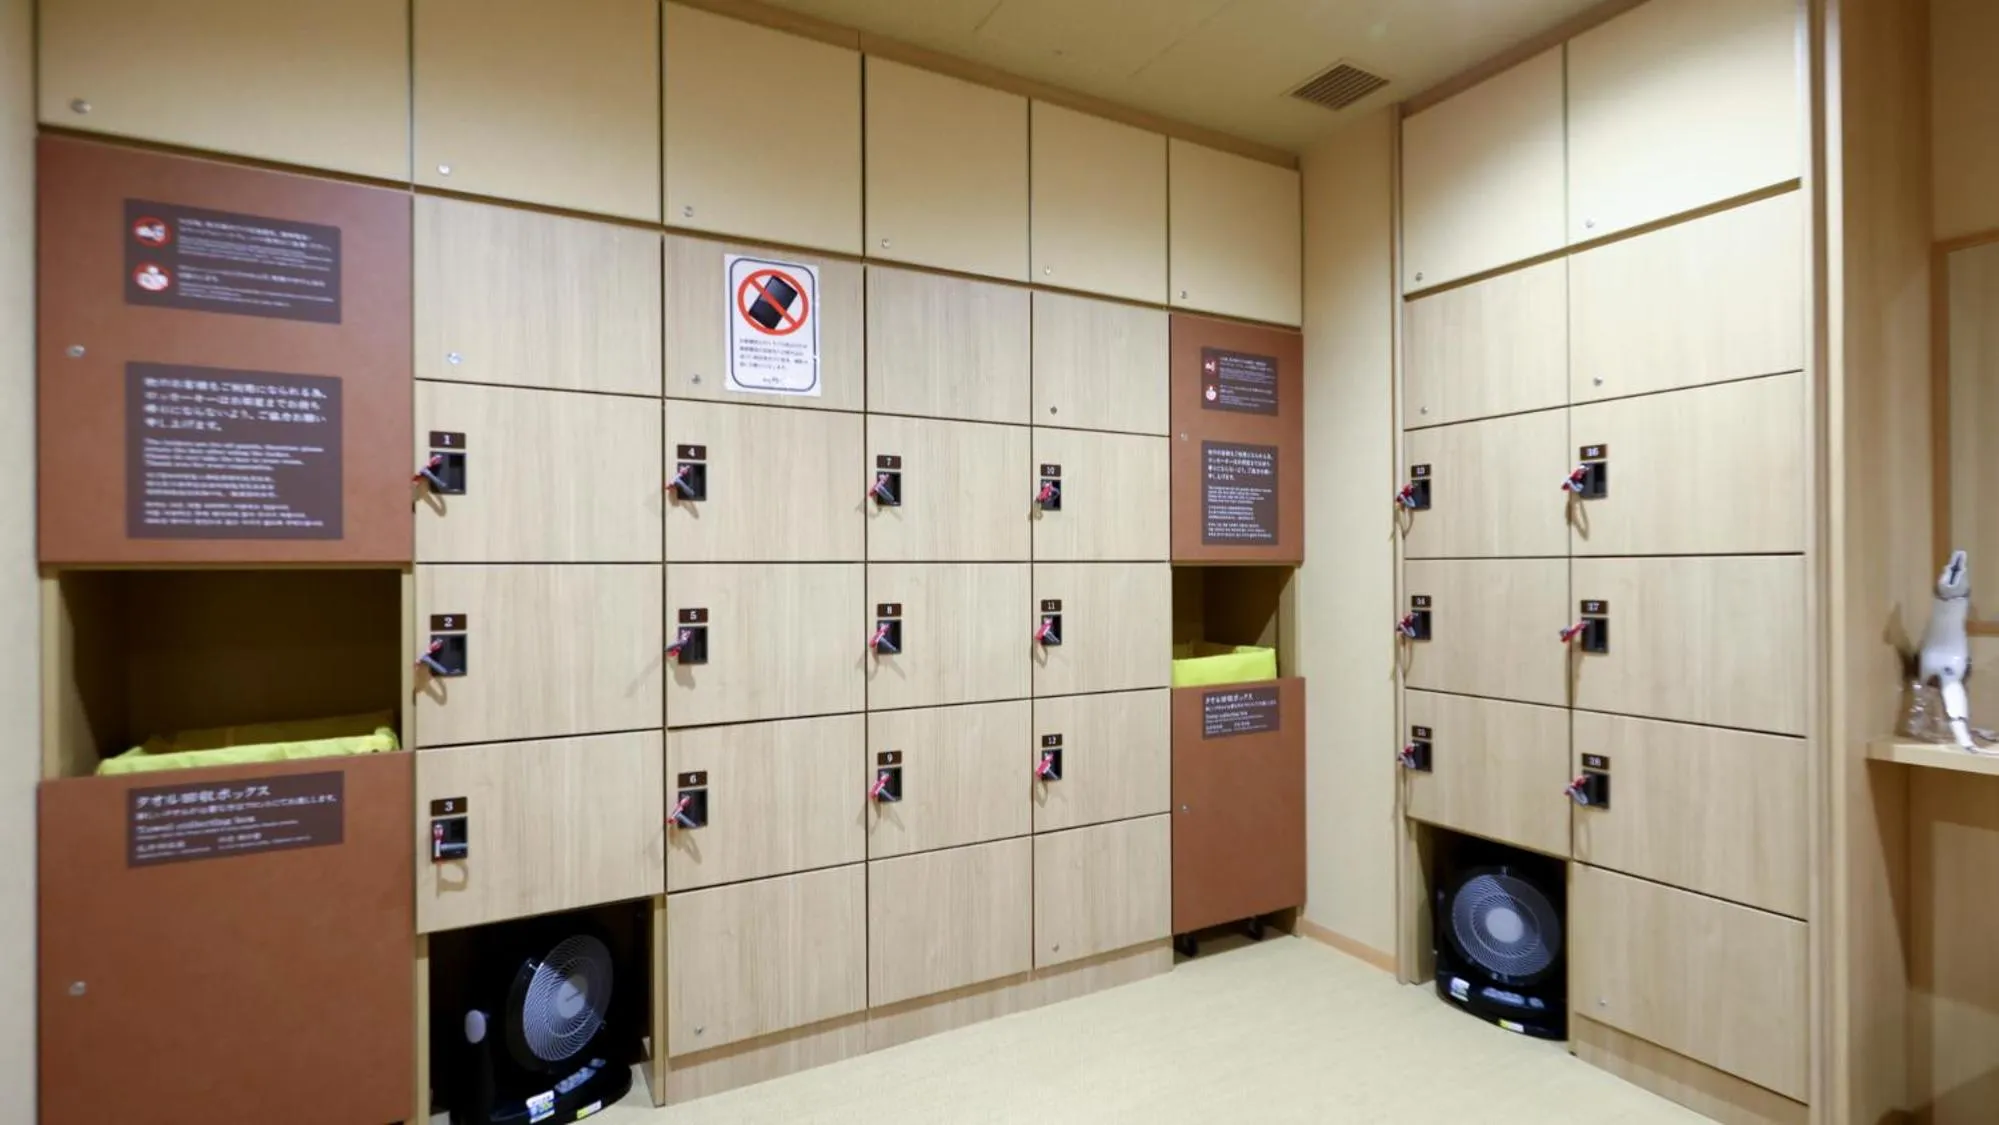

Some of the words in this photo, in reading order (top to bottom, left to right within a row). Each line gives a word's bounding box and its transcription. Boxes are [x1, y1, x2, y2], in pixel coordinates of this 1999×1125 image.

[443, 434, 452, 445] 1
[688, 447, 695, 457] 4
[690, 610, 697, 620] 5
[444, 616, 453, 628] 2
[690, 774, 697, 784] 6
[444, 800, 453, 812] 3
